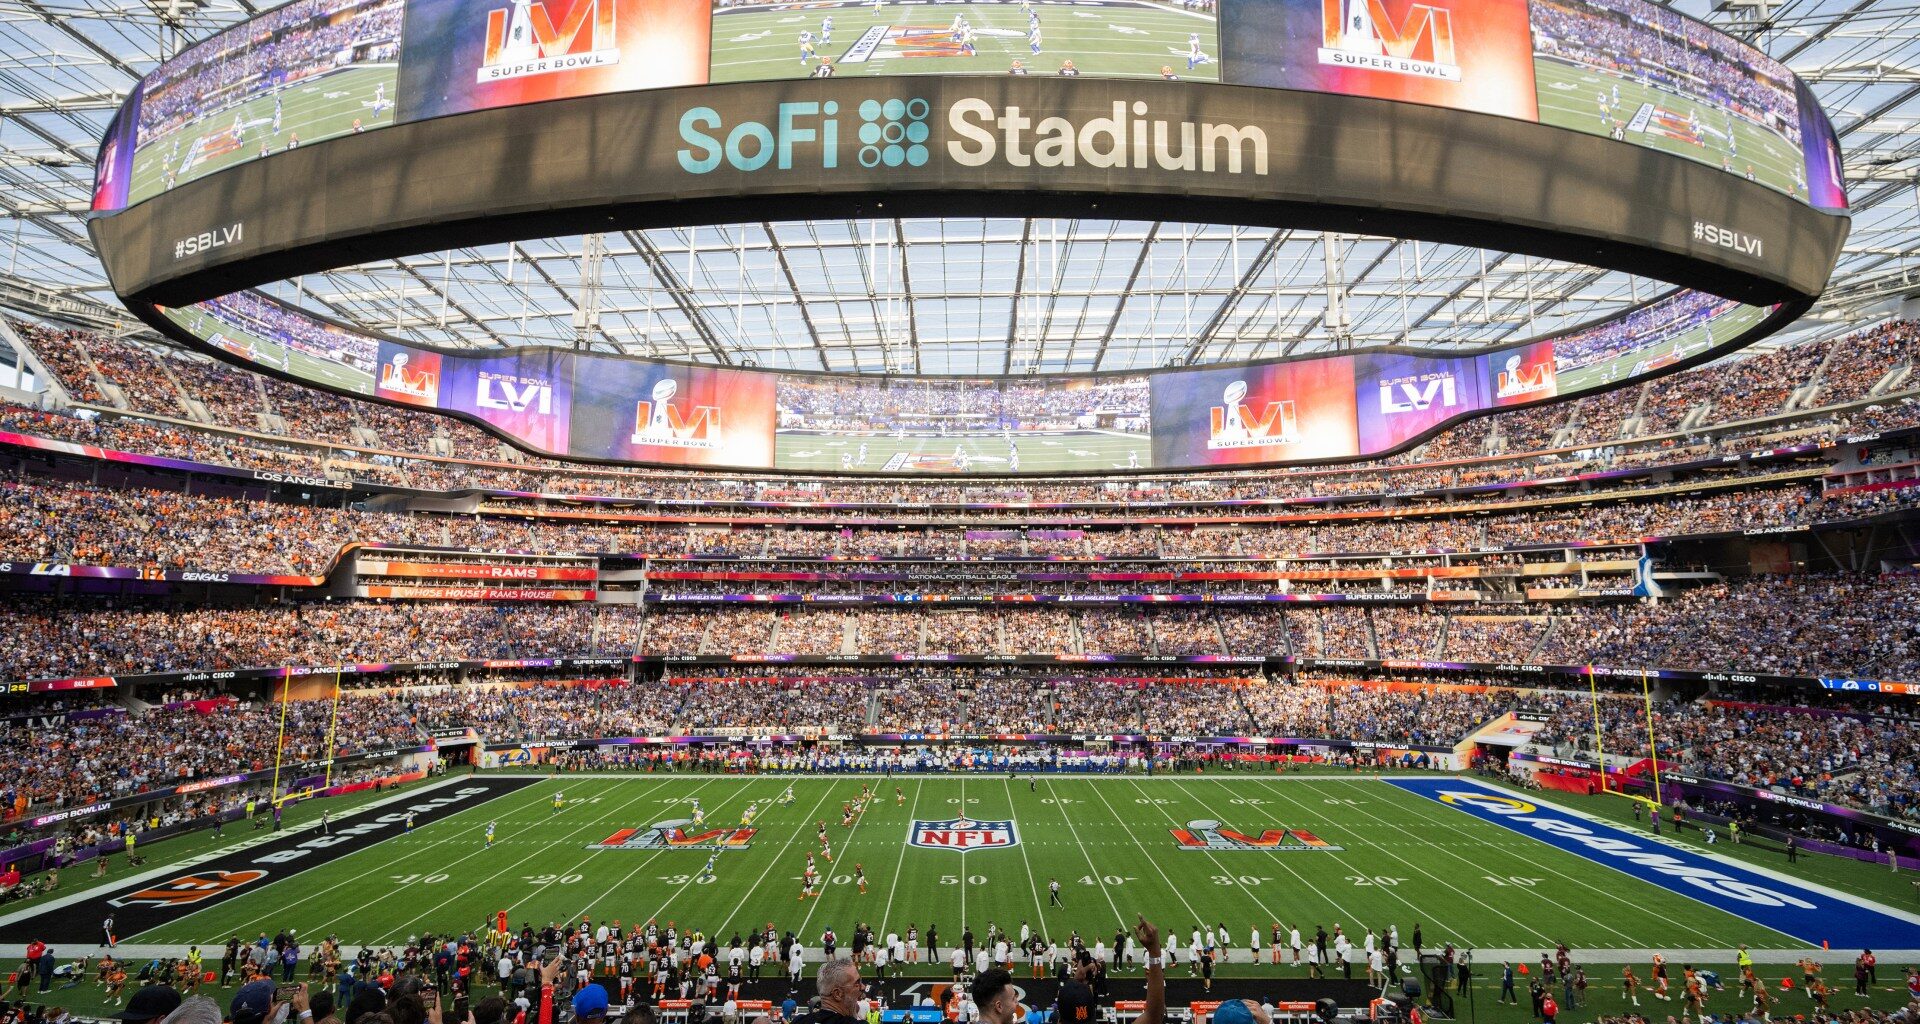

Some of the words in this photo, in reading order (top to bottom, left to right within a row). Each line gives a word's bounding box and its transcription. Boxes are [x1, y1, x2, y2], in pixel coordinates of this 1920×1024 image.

[491, 62, 547, 78] SUPER
[554, 55, 604, 68] BOWL
[1333, 54, 1392, 69] SUPER
[1400, 62, 1447, 76] BOWL
[677, 100, 838, 174] SoFi
[946, 98, 1268, 176] Stadium
[175, 222, 242, 258] #SBLVI
[1693, 222, 1762, 258] #SBLVI
[479, 371, 518, 382] SUPER
[520, 378, 552, 387] BOWL
[1379, 376, 1417, 388] SUPER
[1420, 371, 1454, 382] BOWL
[476, 378, 552, 414] LVI
[1380, 377, 1457, 414] LVI
[642, 437, 680, 445] SUPER
[1258, 438, 1291, 446] BOWL
[254, 471, 282, 482] LOS
[284, 476, 352, 489] ANGELES
[1764, 524, 1810, 534] ANGELES
[182, 572, 229, 582] BENGALS
[491, 567, 538, 578] RAMS
[446, 590, 486, 598] HOUSE?
[490, 590, 518, 598] RAMS
[520, 590, 556, 599] HOUSE!
[312, 666, 356, 674] ANGELES
[1612, 669, 1660, 677] ANGELES
[182, 783, 200, 792] LOS
[201, 776, 240, 789] ANGELES
[1759, 791, 1787, 803] SUPER
[1787, 796, 1812, 808] BOWL
[1812, 802, 1824, 811] LVI
[37, 812, 69, 825] SUPER
[70, 806, 98, 818] BOWL
[98, 802, 111, 811] LVI
[251, 787, 490, 864] BENGALS
[921, 831, 1006, 846] NFL
[1506, 816, 1818, 909] RAMS
[394, 874, 450, 884] 10
[528, 874, 583, 884] 20
[666, 875, 717, 884] 30
[940, 875, 988, 885] 50
[1077, 875, 1124, 885] 40
[1211, 876, 1261, 885] 30
[1345, 876, 1398, 886] 20
[1481, 877, 1536, 886] 10
[621, 965, 629, 973] 70
